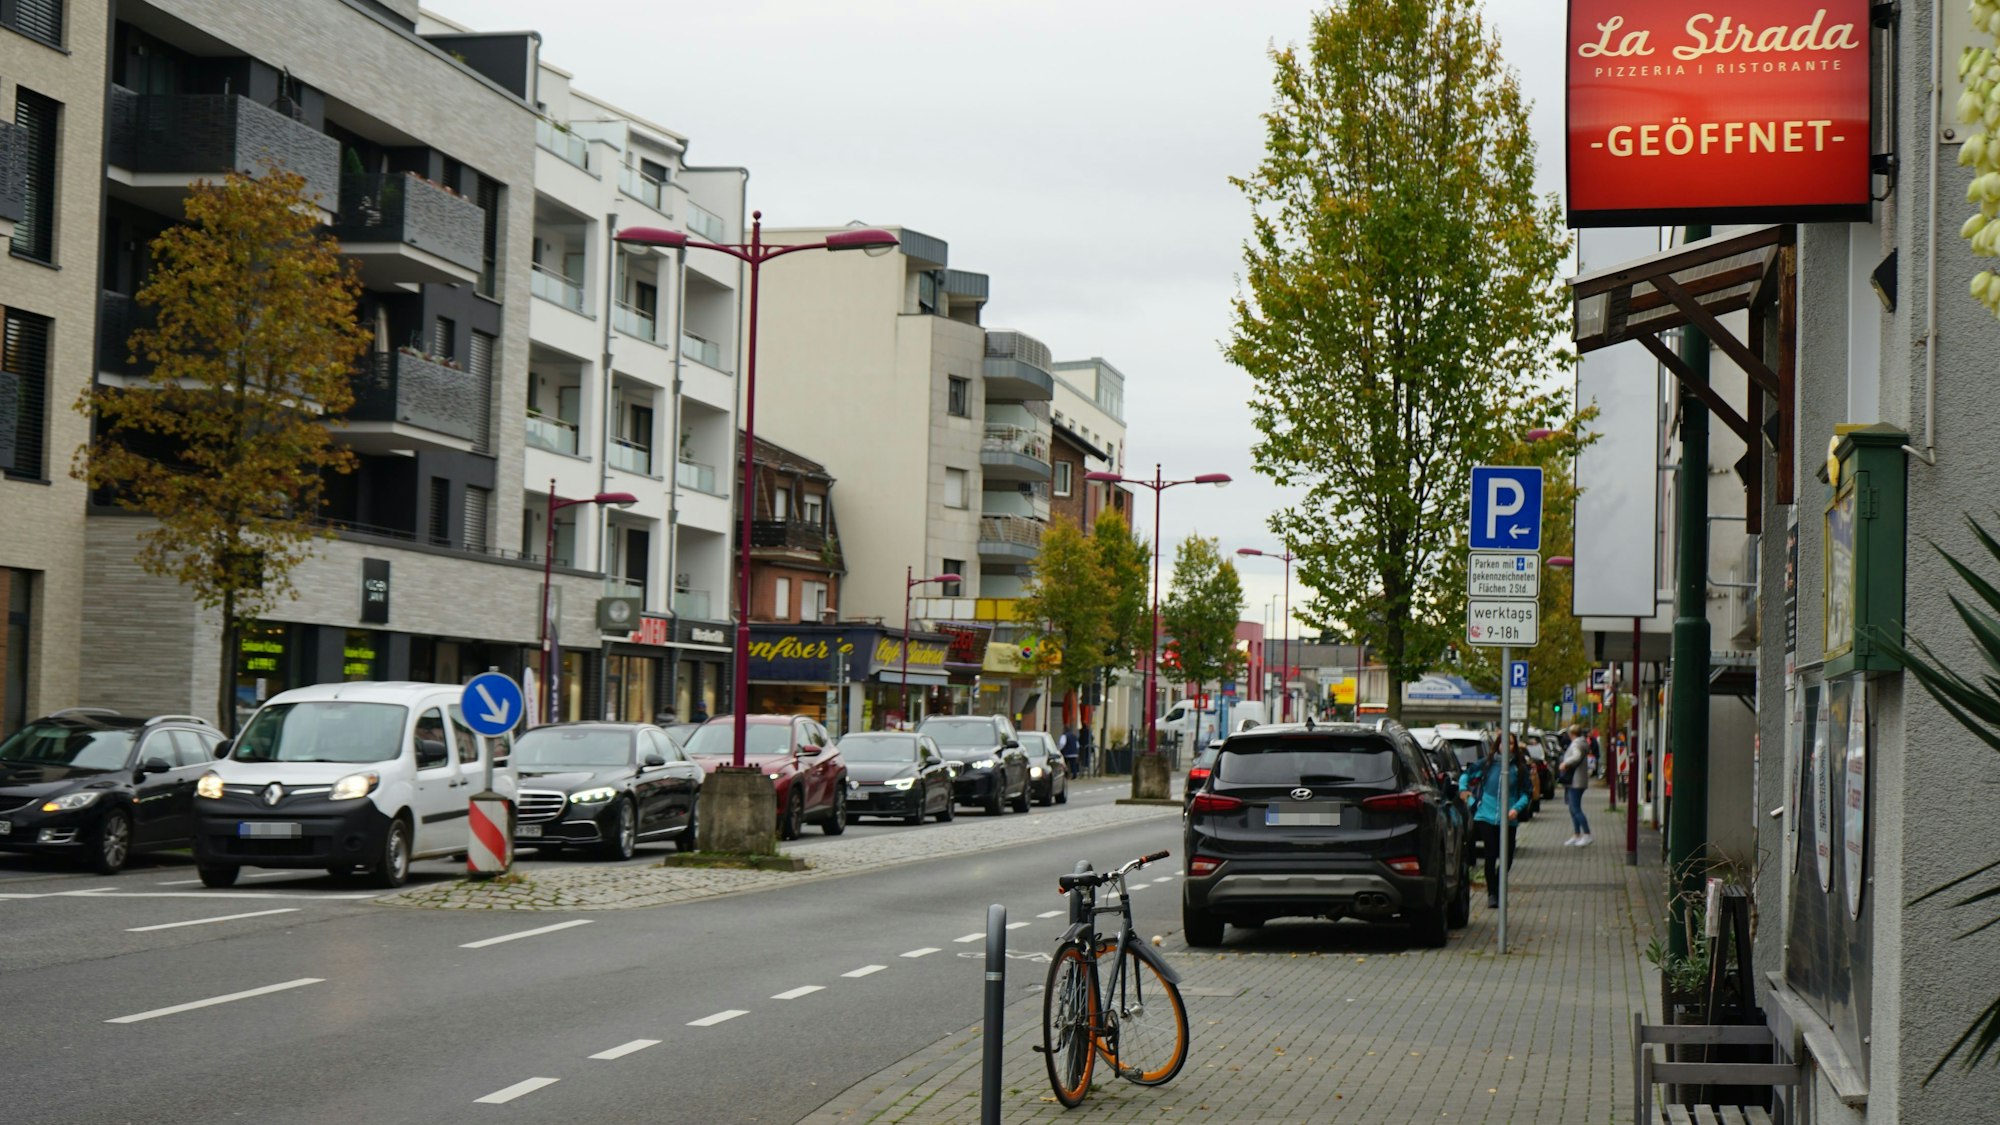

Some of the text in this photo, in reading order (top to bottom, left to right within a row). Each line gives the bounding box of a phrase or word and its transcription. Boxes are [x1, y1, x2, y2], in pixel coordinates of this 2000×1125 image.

[1578, 8, 1860, 61] La Strada
[1595, 64, 1685, 78] PIZZERIA
[1716, 59, 1842, 74] RISTORANTE
[1486, 477, 1526, 539] P
[1475, 558, 1534, 569] Parken mit in
[1472, 571, 1536, 583] gekennzeichneten
[1478, 583, 1506, 593] Flächen
[1474, 606, 1532, 623] werktags
[1487, 626, 1519, 639] 9-18h
